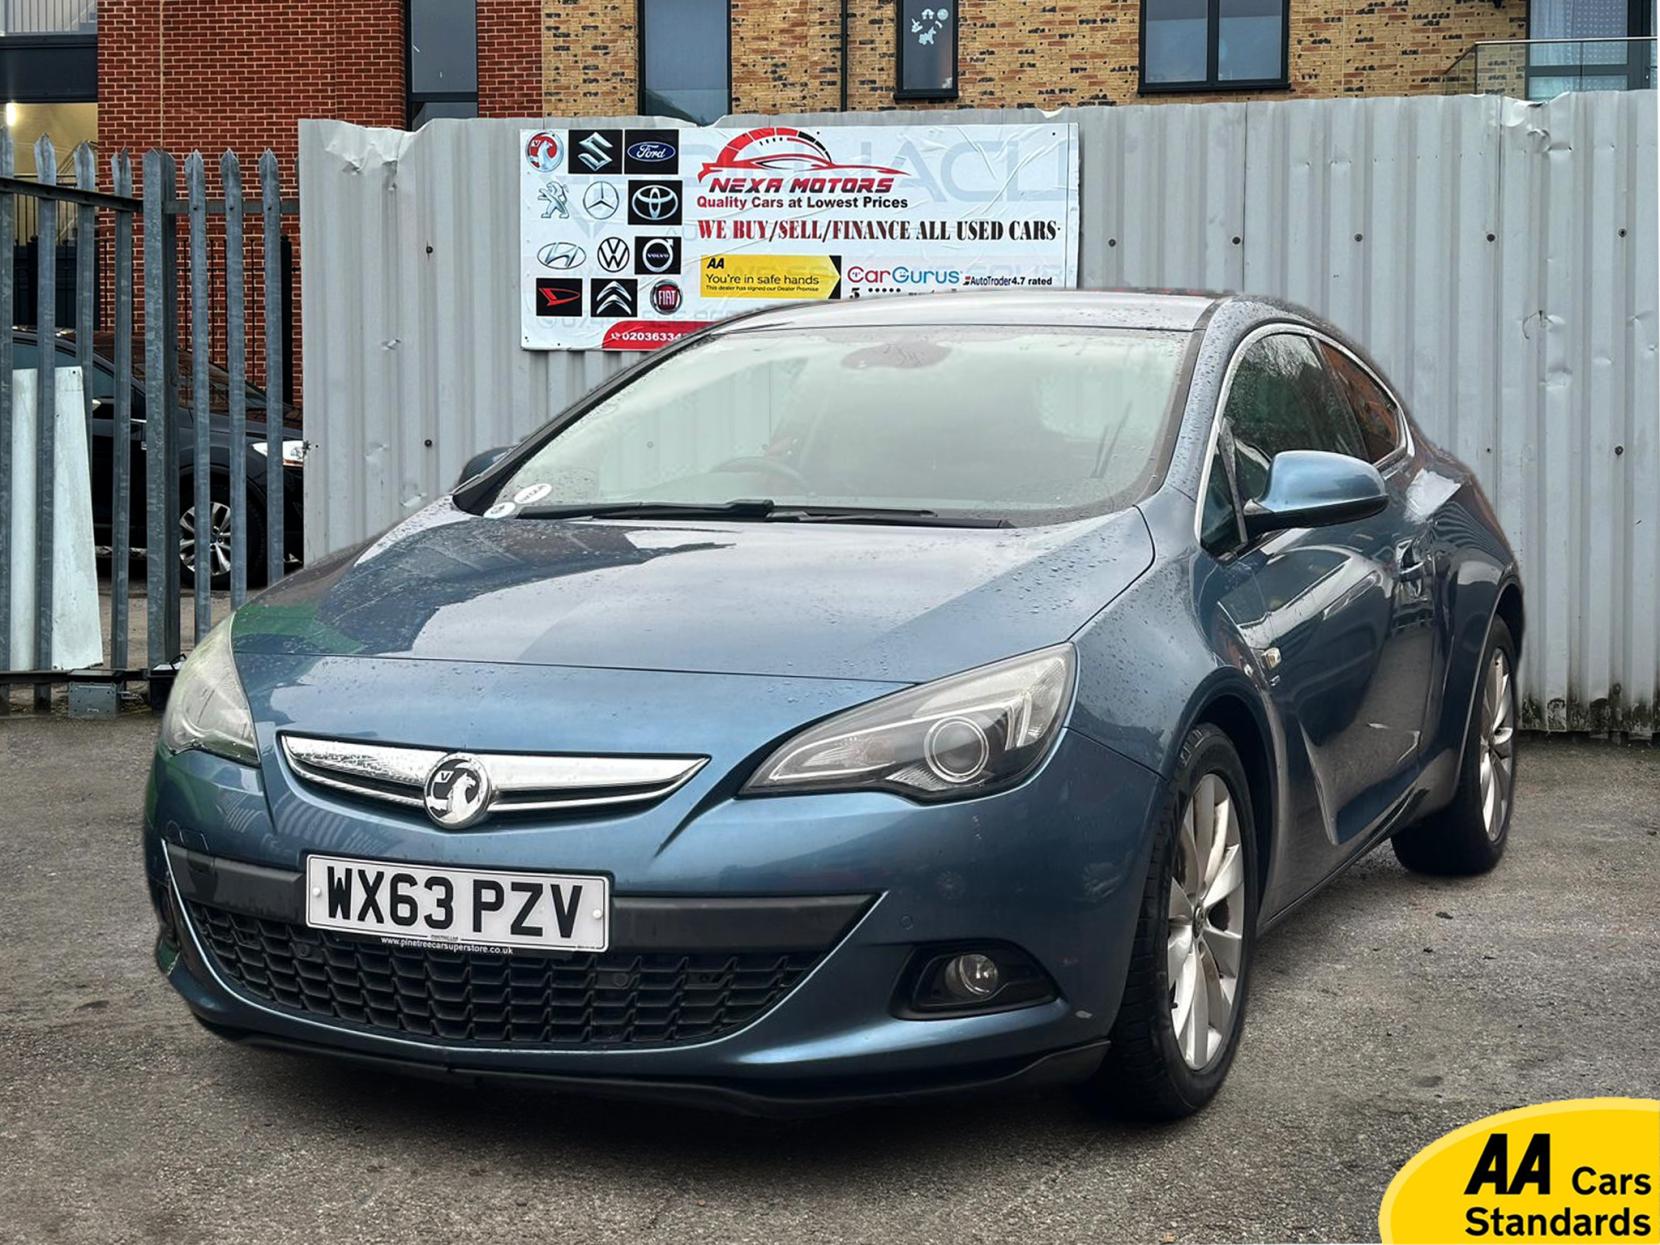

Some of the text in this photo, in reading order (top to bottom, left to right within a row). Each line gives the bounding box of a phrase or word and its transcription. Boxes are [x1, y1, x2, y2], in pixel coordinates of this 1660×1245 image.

[636, 144, 666, 159] Ford
[709, 178, 895, 194] NEXA MOTORS
[697, 196, 908, 211] Quality Cars at Lowest Prices
[697, 220, 727, 240] WE
[916, 220, 951, 240] ALL
[956, 220, 1004, 241] USED
[1008, 220, 1057, 241] CARS
[706, 257, 725, 269] AA
[706, 273, 820, 286] You're in safe hands
[847, 266, 960, 284] CarGurus
[1027, 276, 1053, 286] rated
[658, 290, 677, 306] FIAT
[327, 866, 583, 939] WX63 PZV
[381, 936, 513, 955] www.pinetreecarsuperstore.co.uk
